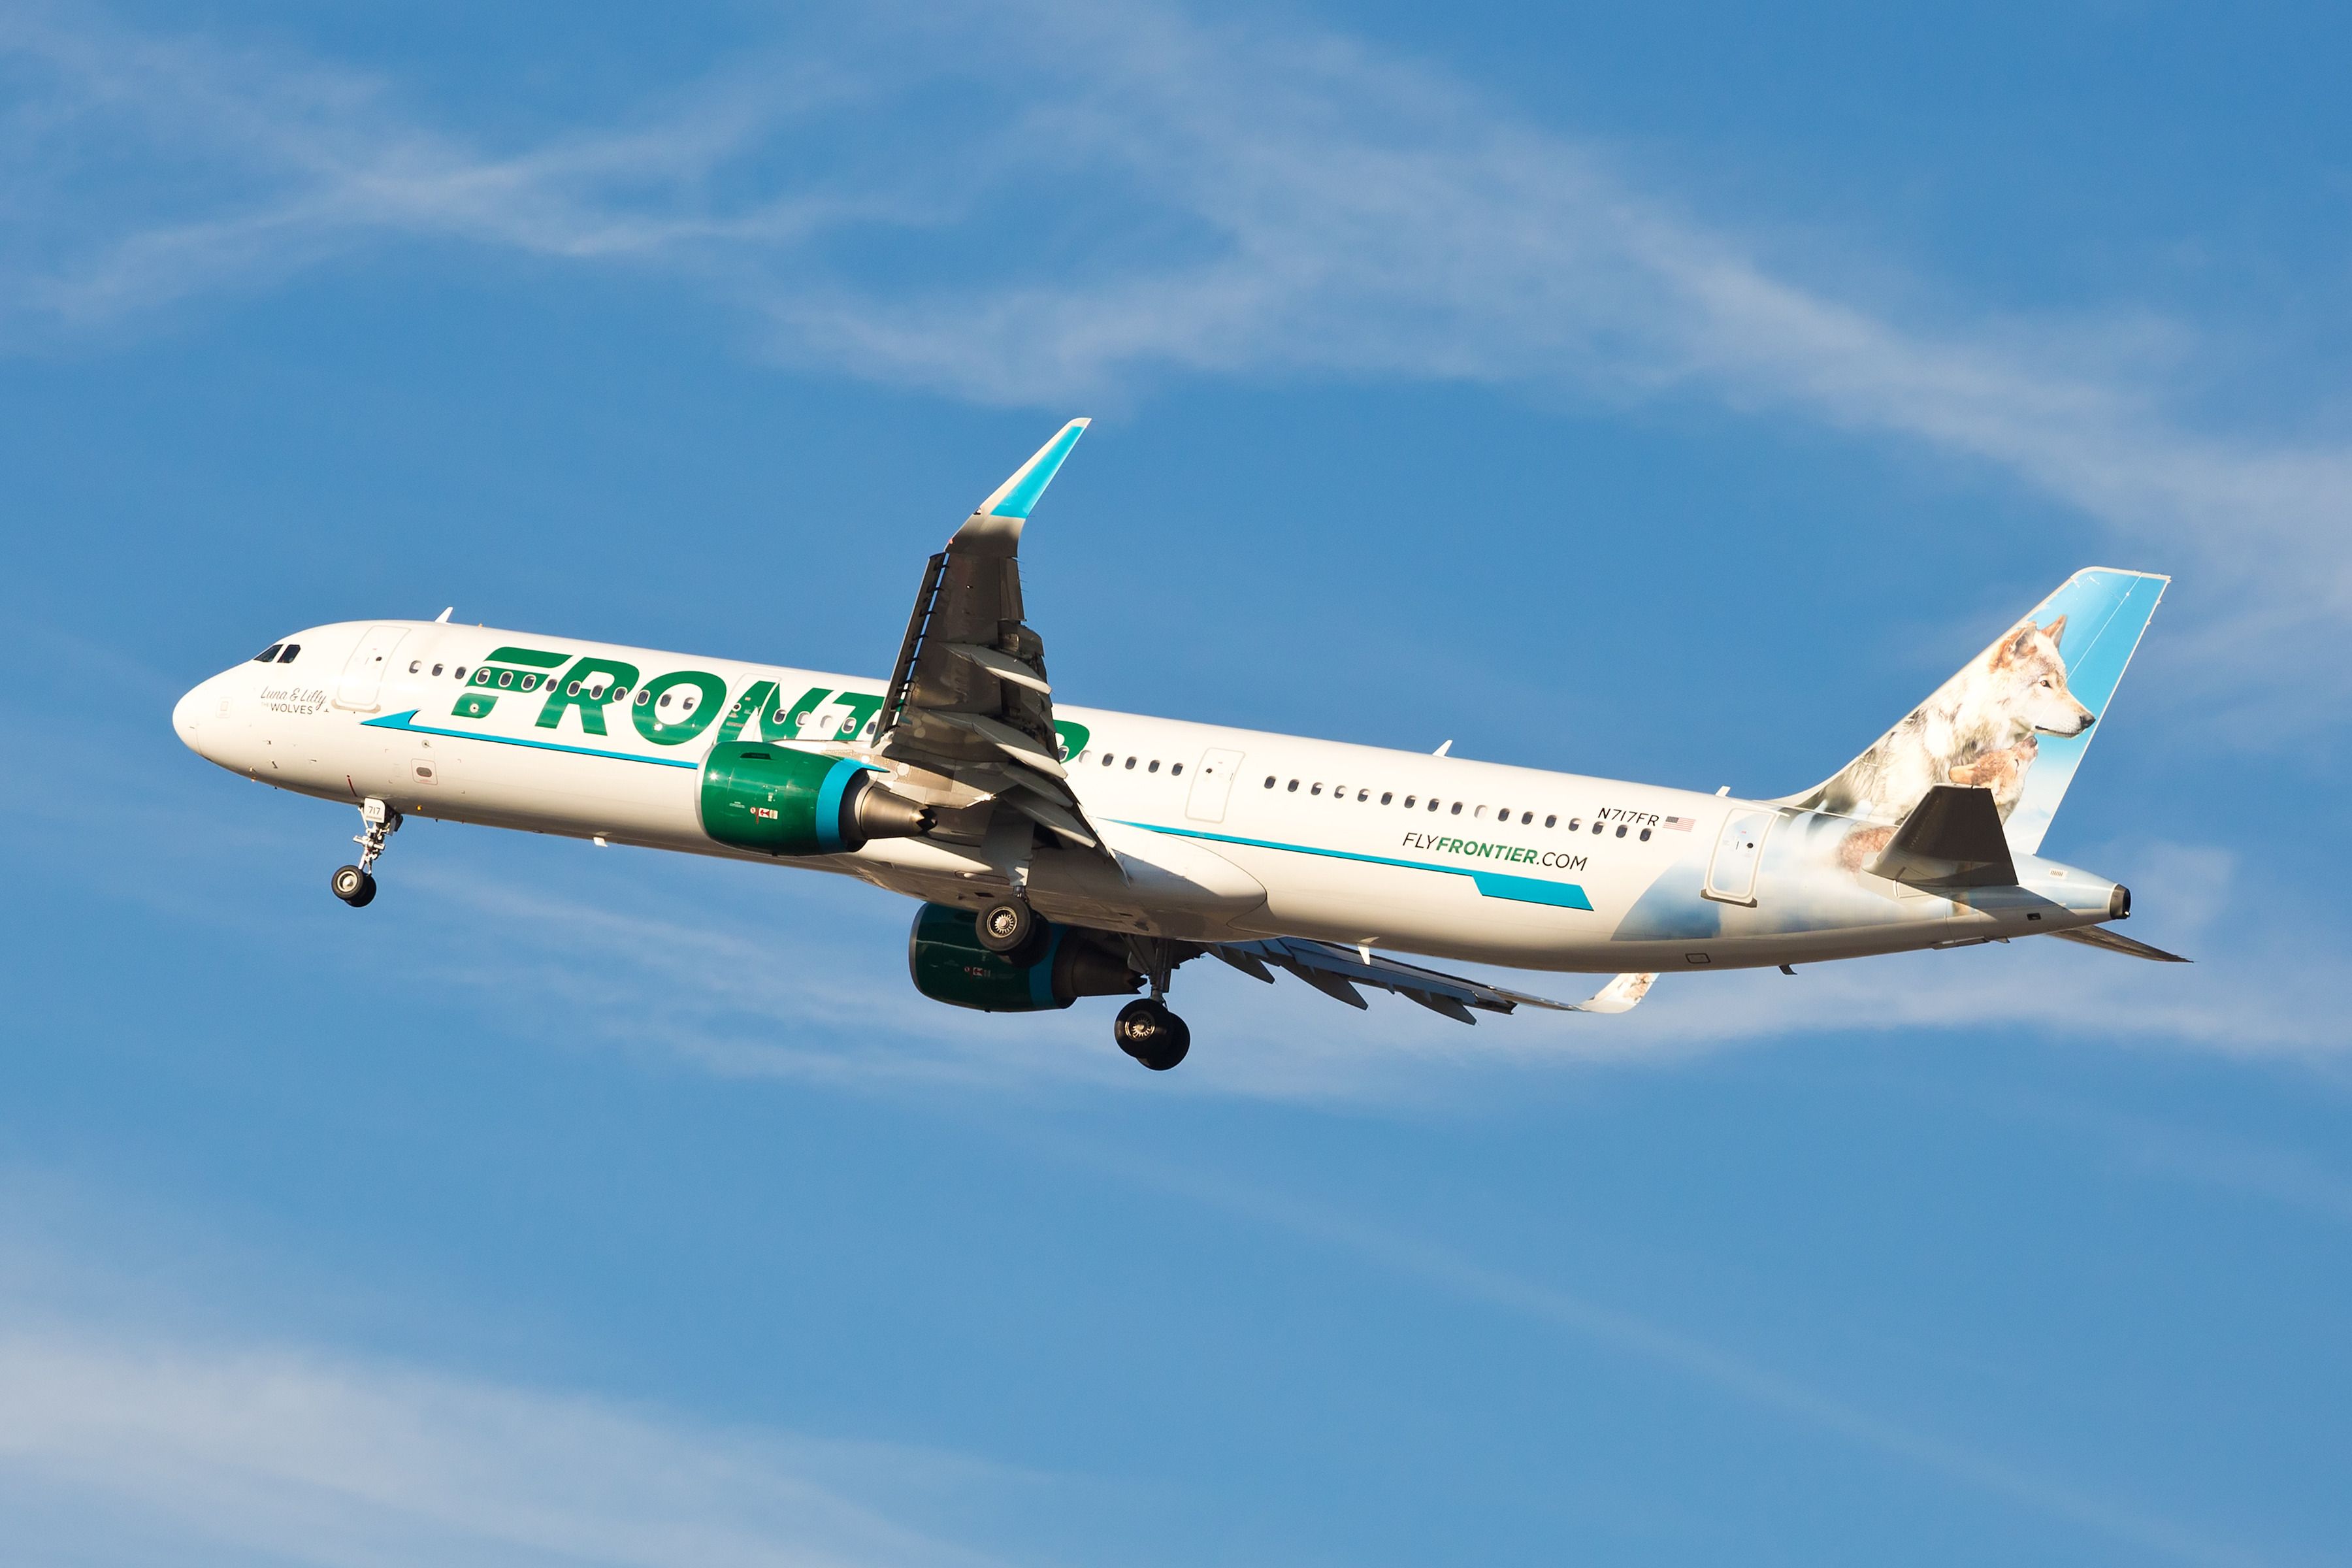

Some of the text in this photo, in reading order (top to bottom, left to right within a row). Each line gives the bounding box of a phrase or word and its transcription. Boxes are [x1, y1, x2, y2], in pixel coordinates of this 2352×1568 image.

[261, 686, 327, 711] Luna & Lilly
[270, 702, 313, 715] WOLVES
[368, 806, 381, 815] 717
[1597, 808, 1659, 826] N717FR
[1402, 832, 1588, 871] FLYFRONTIER.COM
